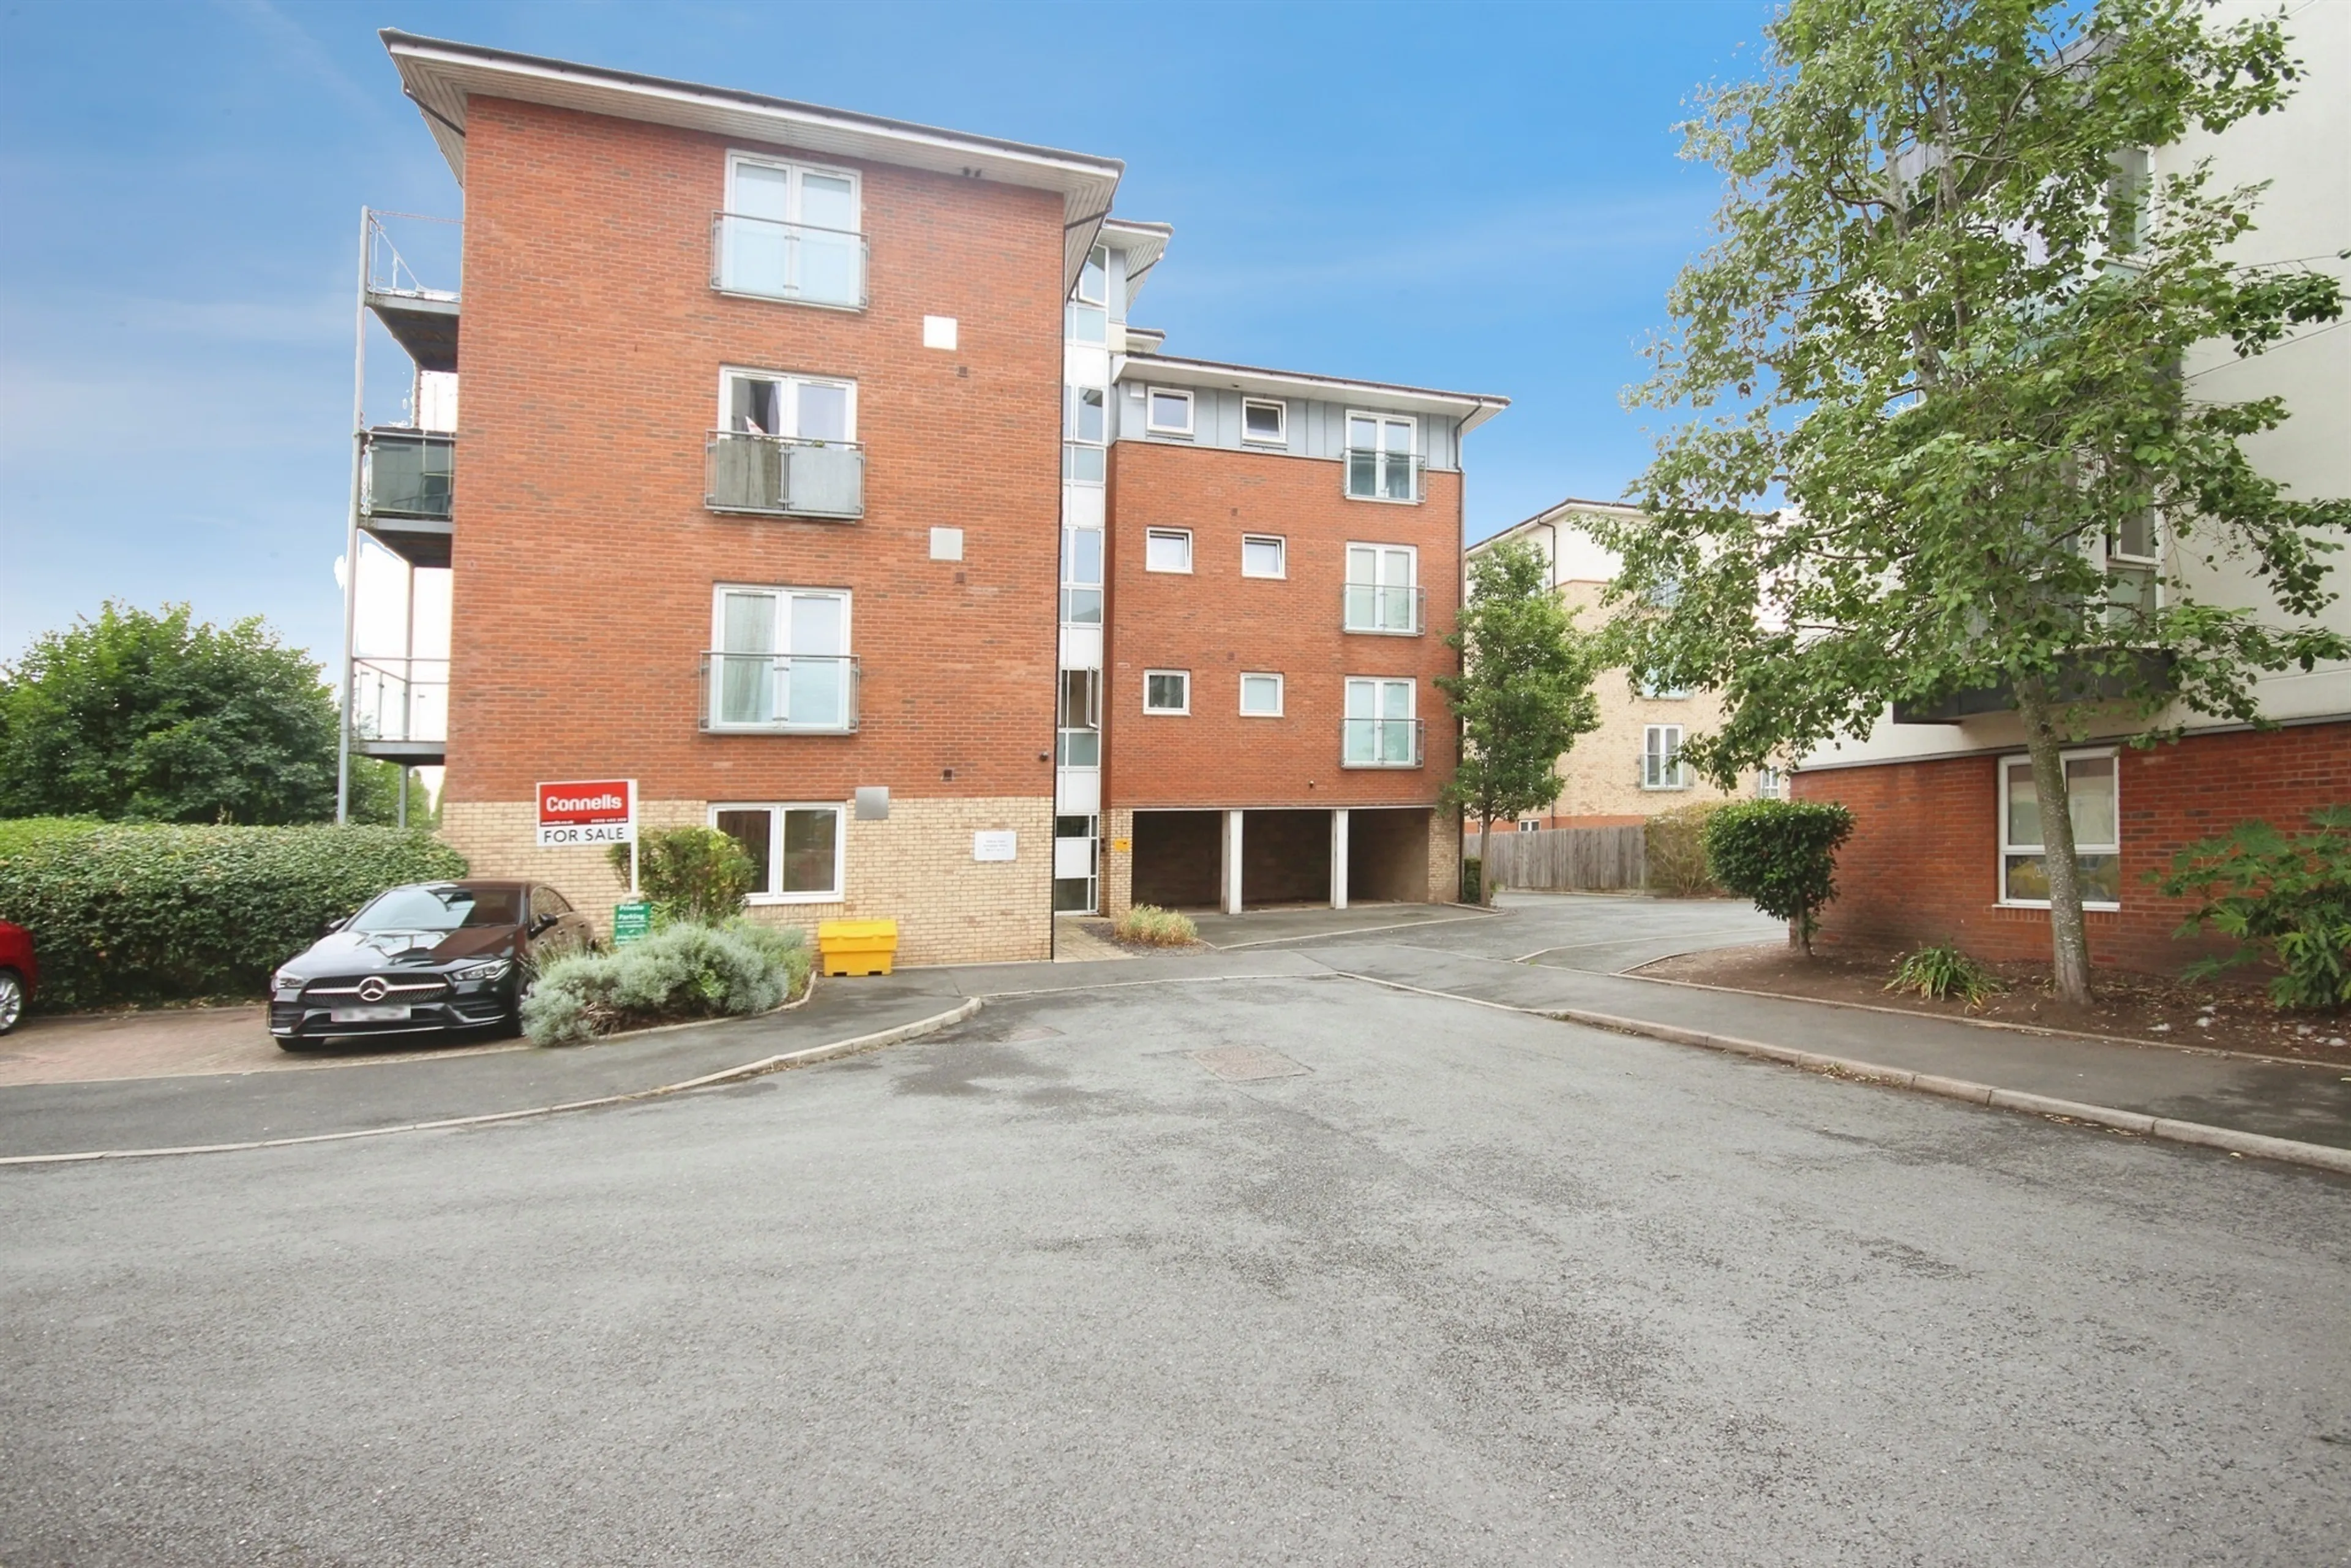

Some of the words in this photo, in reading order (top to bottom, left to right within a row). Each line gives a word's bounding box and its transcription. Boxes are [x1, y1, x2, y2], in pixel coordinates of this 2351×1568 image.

[546, 793, 622, 812] Connells
[544, 829, 578, 843] FOR
[585, 827, 624, 841] SALE
